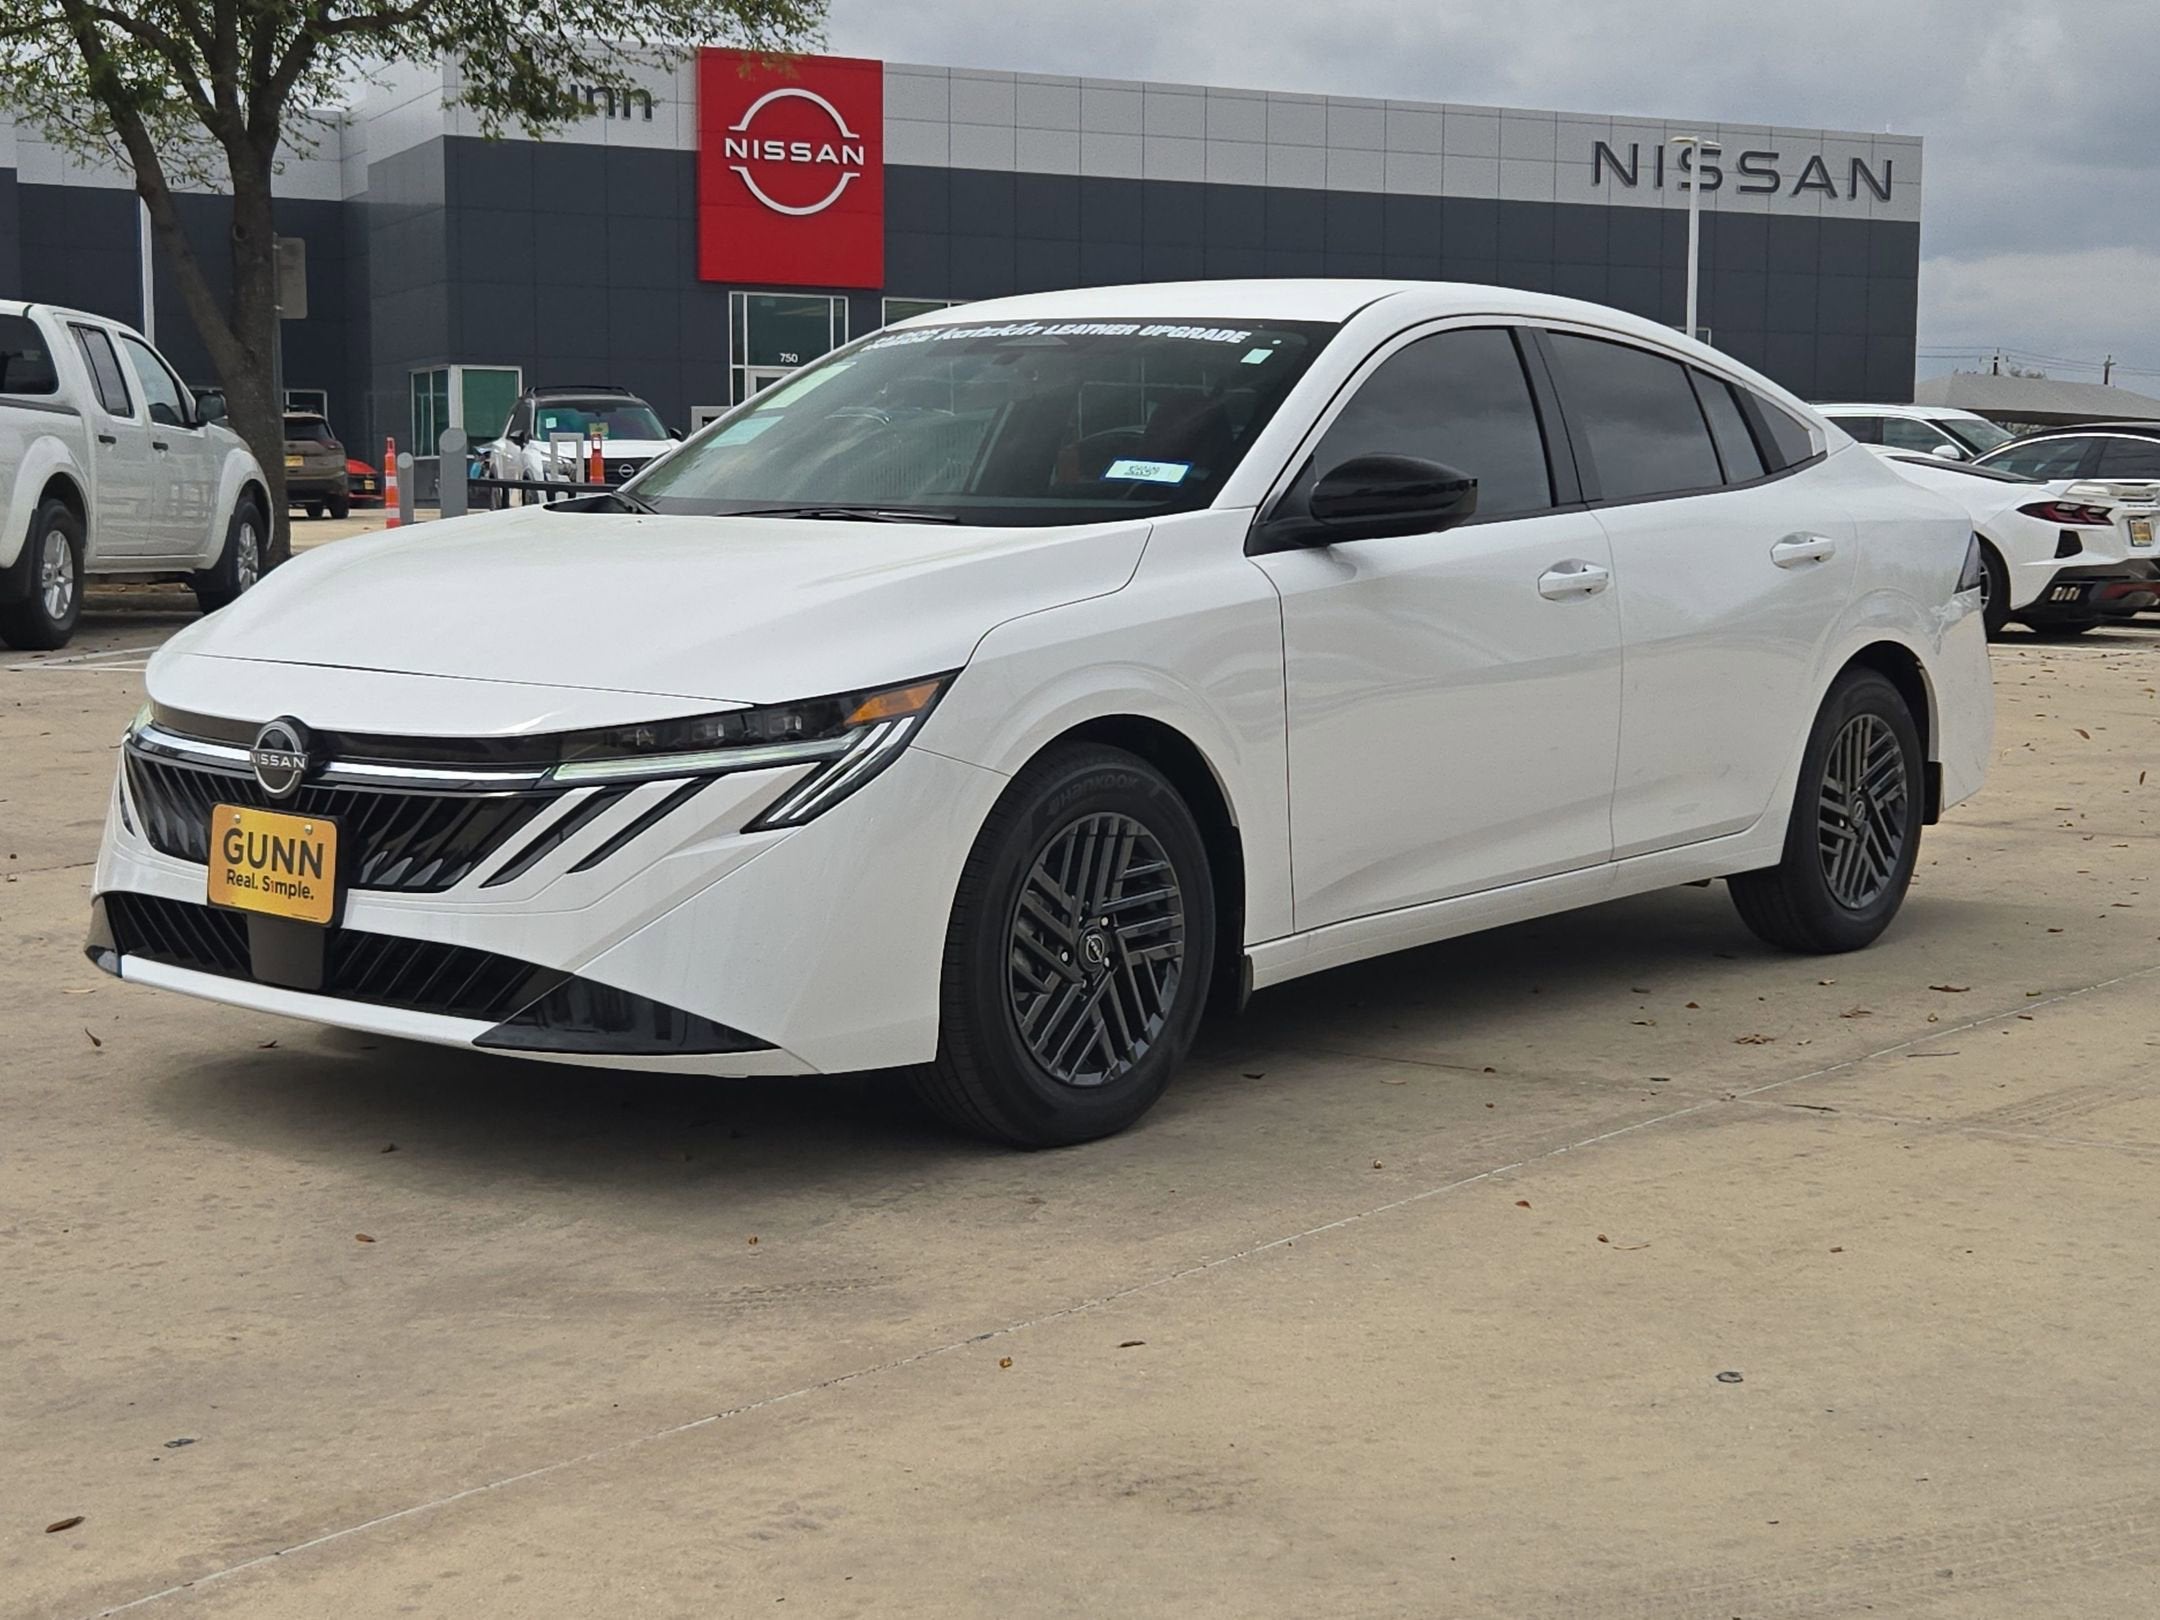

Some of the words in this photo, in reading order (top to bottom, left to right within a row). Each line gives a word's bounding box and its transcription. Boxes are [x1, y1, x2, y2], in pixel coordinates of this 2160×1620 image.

[725, 138, 864, 166] NISSAN
[1591, 141, 1893, 202] NISSAN
[1042, 324, 1140, 335] LEATHER
[1139, 325, 1251, 343] UPGRADE
[779, 352, 798, 363] 750
[250, 752, 306, 768] NISSAN
[223, 827, 324, 880] GUNN
[226, 868, 258, 889] Real.
[262, 875, 314, 900] Simple.
